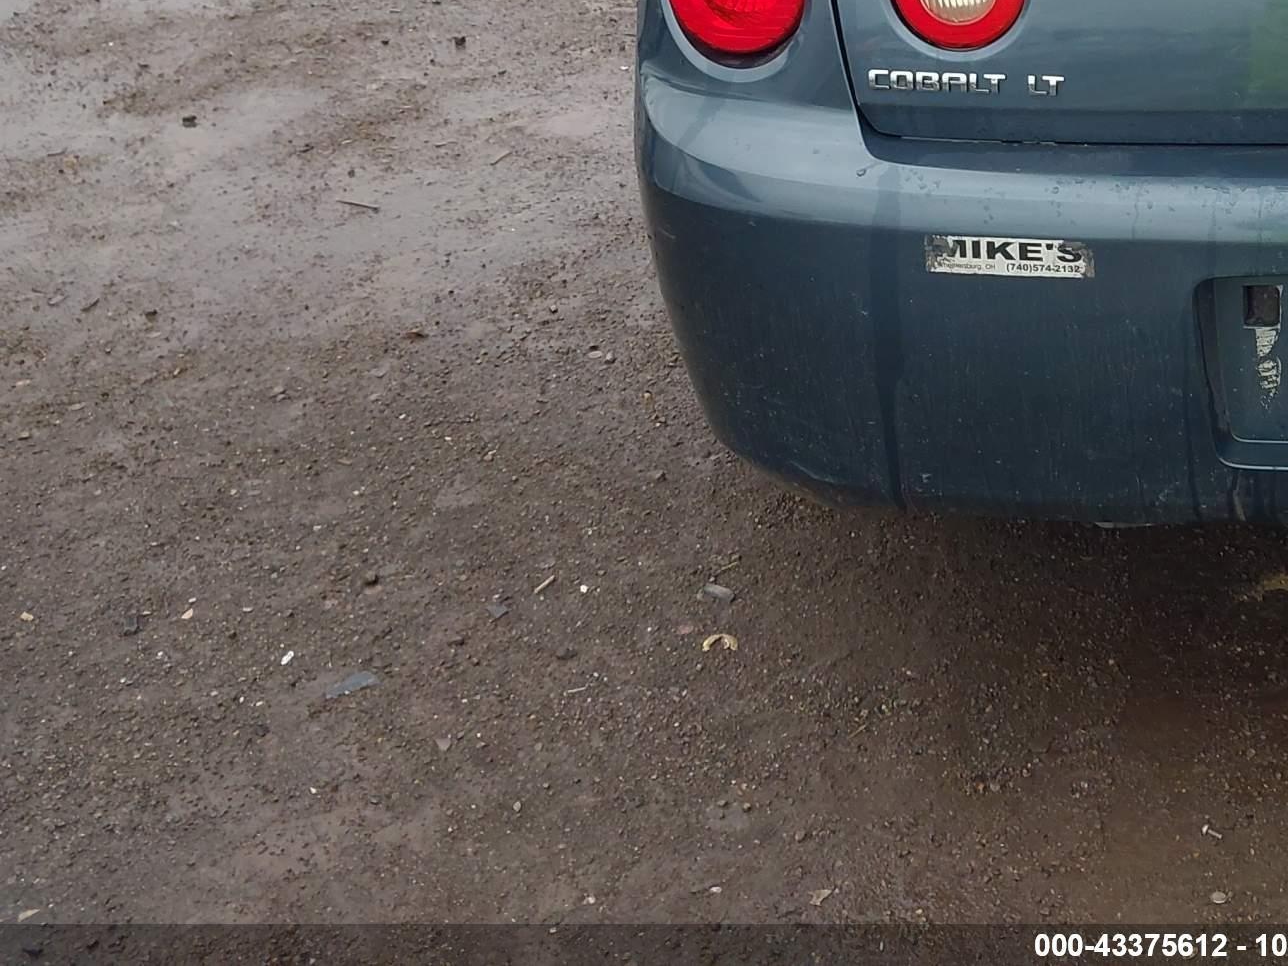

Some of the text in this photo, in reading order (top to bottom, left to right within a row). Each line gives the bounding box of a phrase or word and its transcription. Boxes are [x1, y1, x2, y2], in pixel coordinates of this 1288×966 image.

[868, 69, 1064, 96] COBALT LT
[1006, 262, 1082, 274] (740)574-2132
